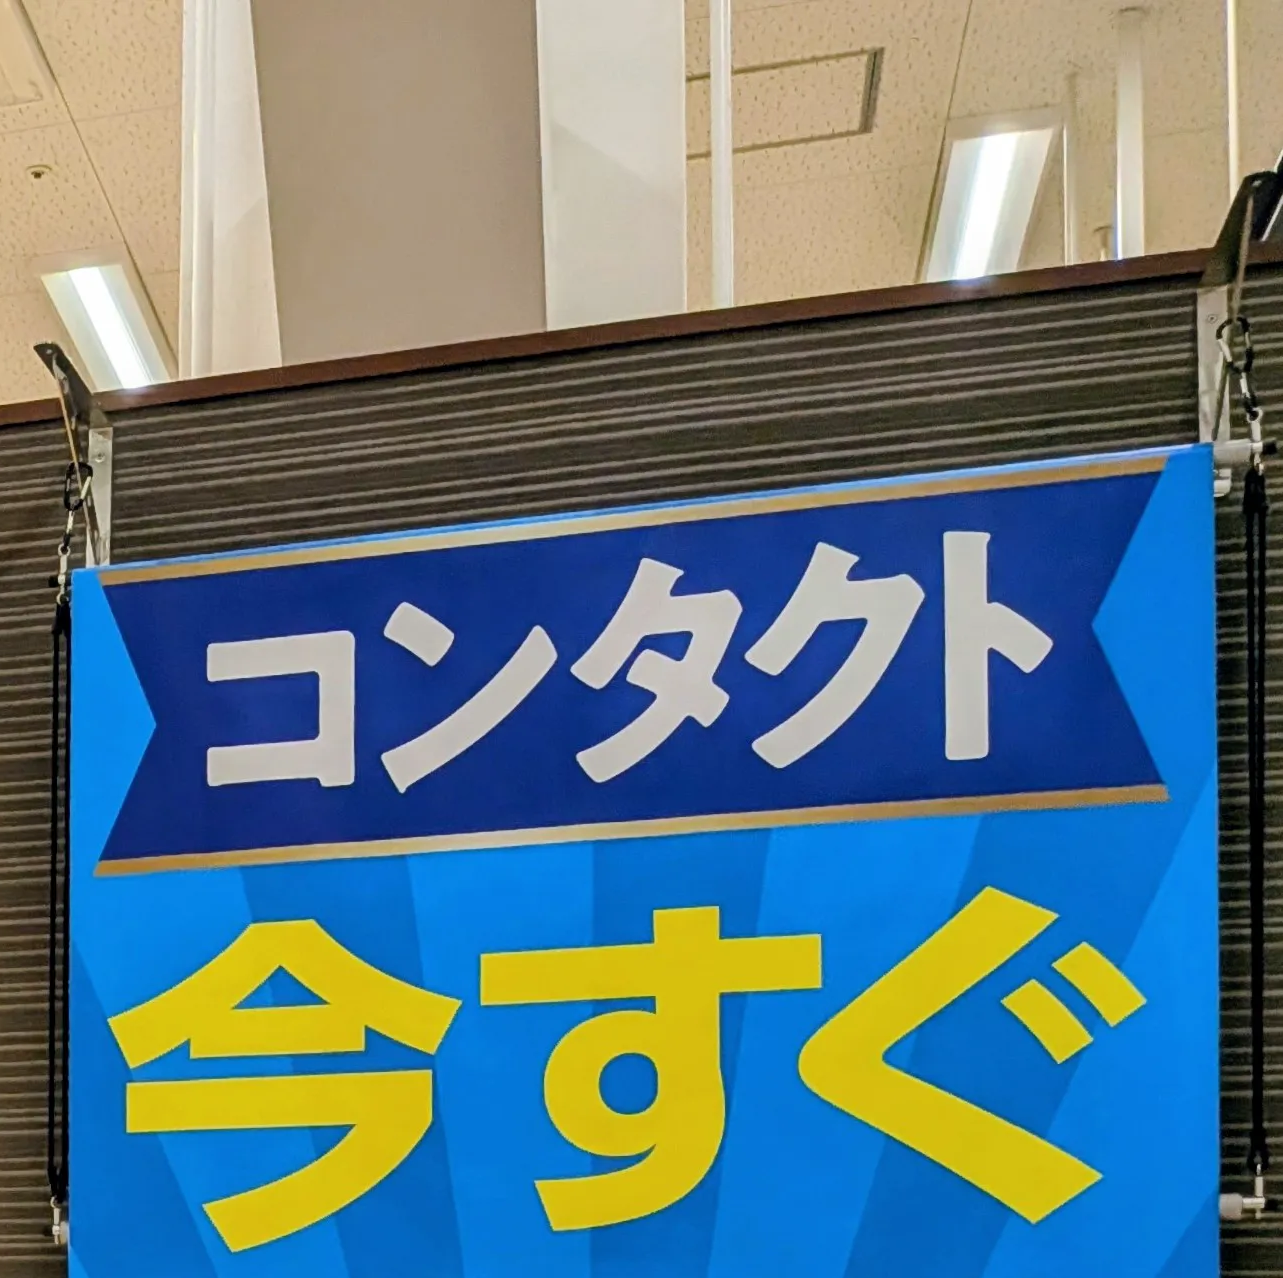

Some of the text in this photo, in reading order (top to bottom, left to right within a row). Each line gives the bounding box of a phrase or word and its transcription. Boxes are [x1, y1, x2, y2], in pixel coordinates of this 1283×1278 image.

[206, 530, 1054, 794] コンタクト
[108, 885, 1146, 1254] 今すぐ
